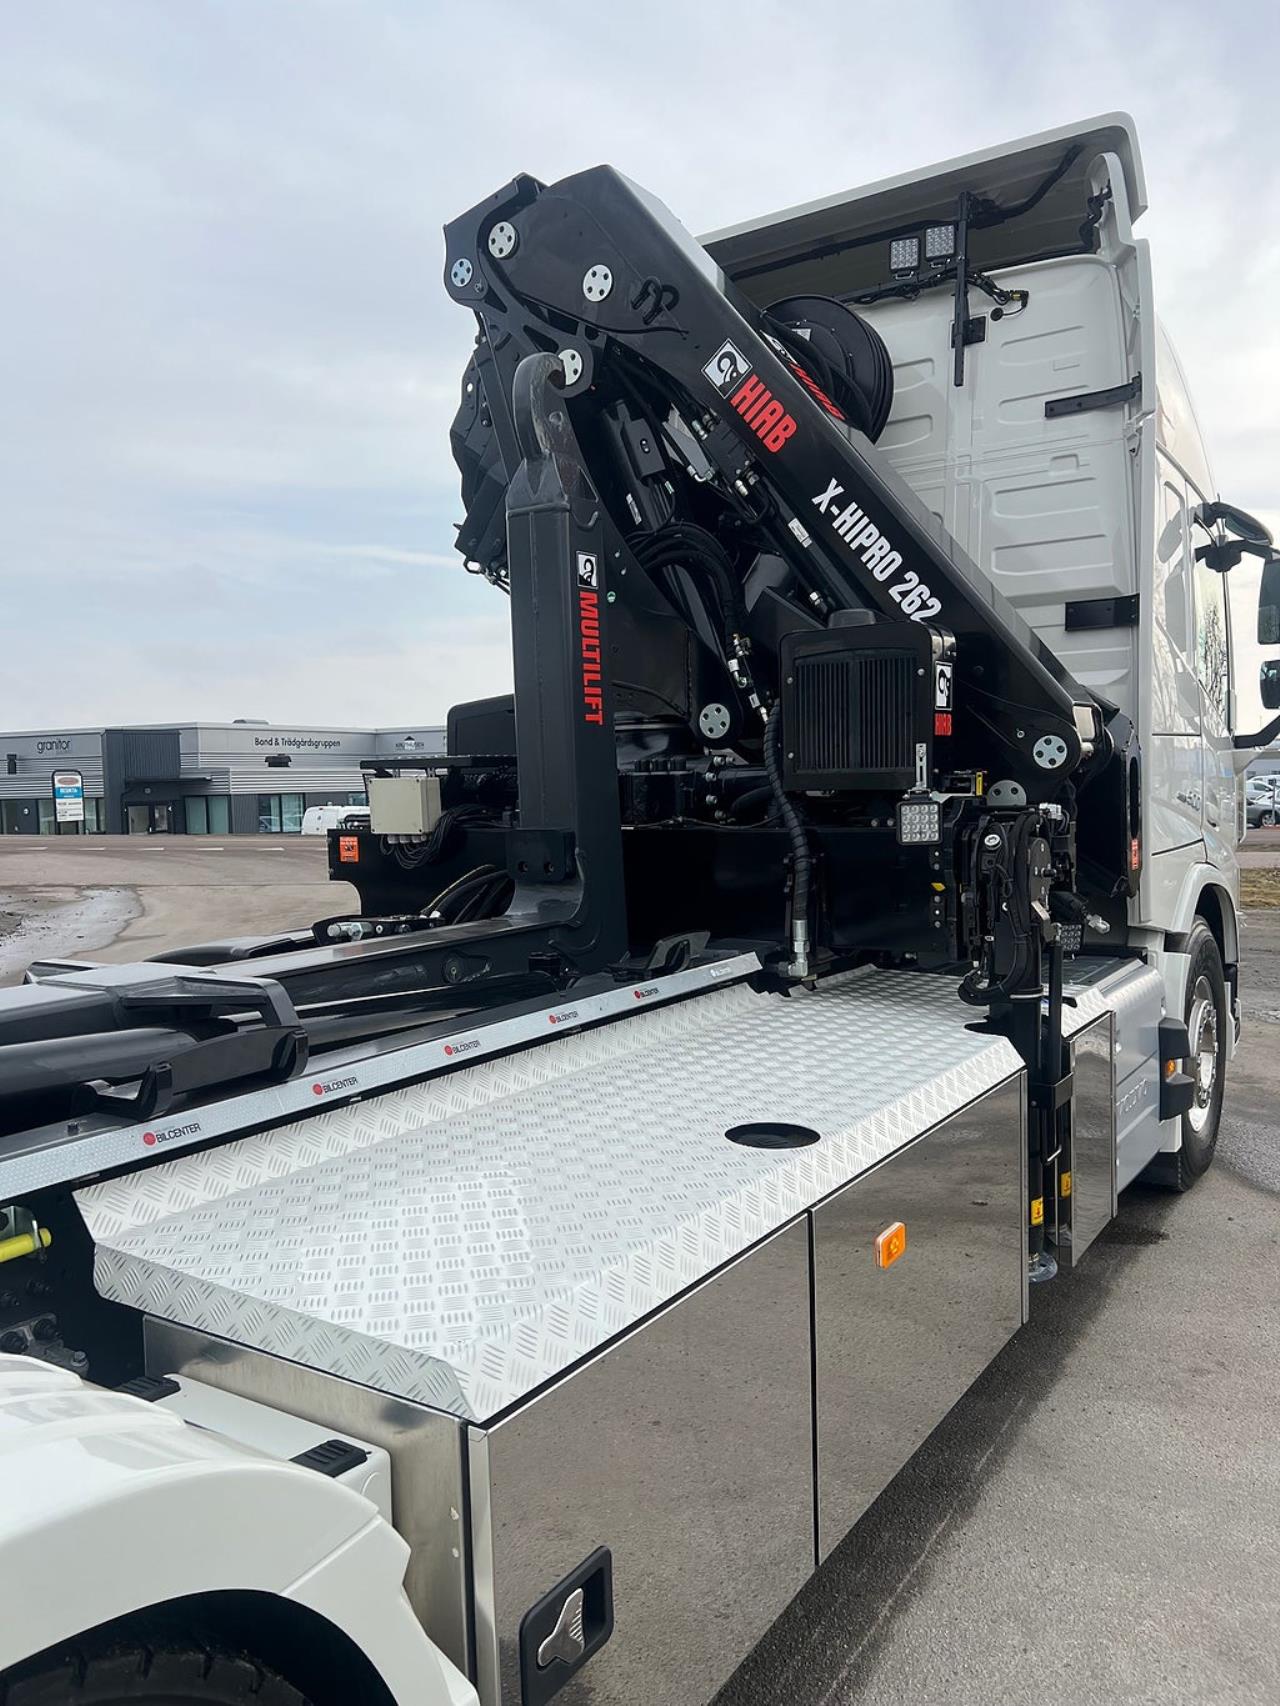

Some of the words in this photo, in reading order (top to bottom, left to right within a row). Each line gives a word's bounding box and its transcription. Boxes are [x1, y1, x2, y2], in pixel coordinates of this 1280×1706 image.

[730, 374, 797, 453] HIAB
[811, 477, 903, 582] X-HIPRO
[888, 570, 942, 624] 262
[579, 591, 604, 726] MULTILIFT
[274, 737, 280, 746] &
[323, 1076, 358, 1093] BILCENTER
[156, 1122, 201, 1143] BILCENTER
